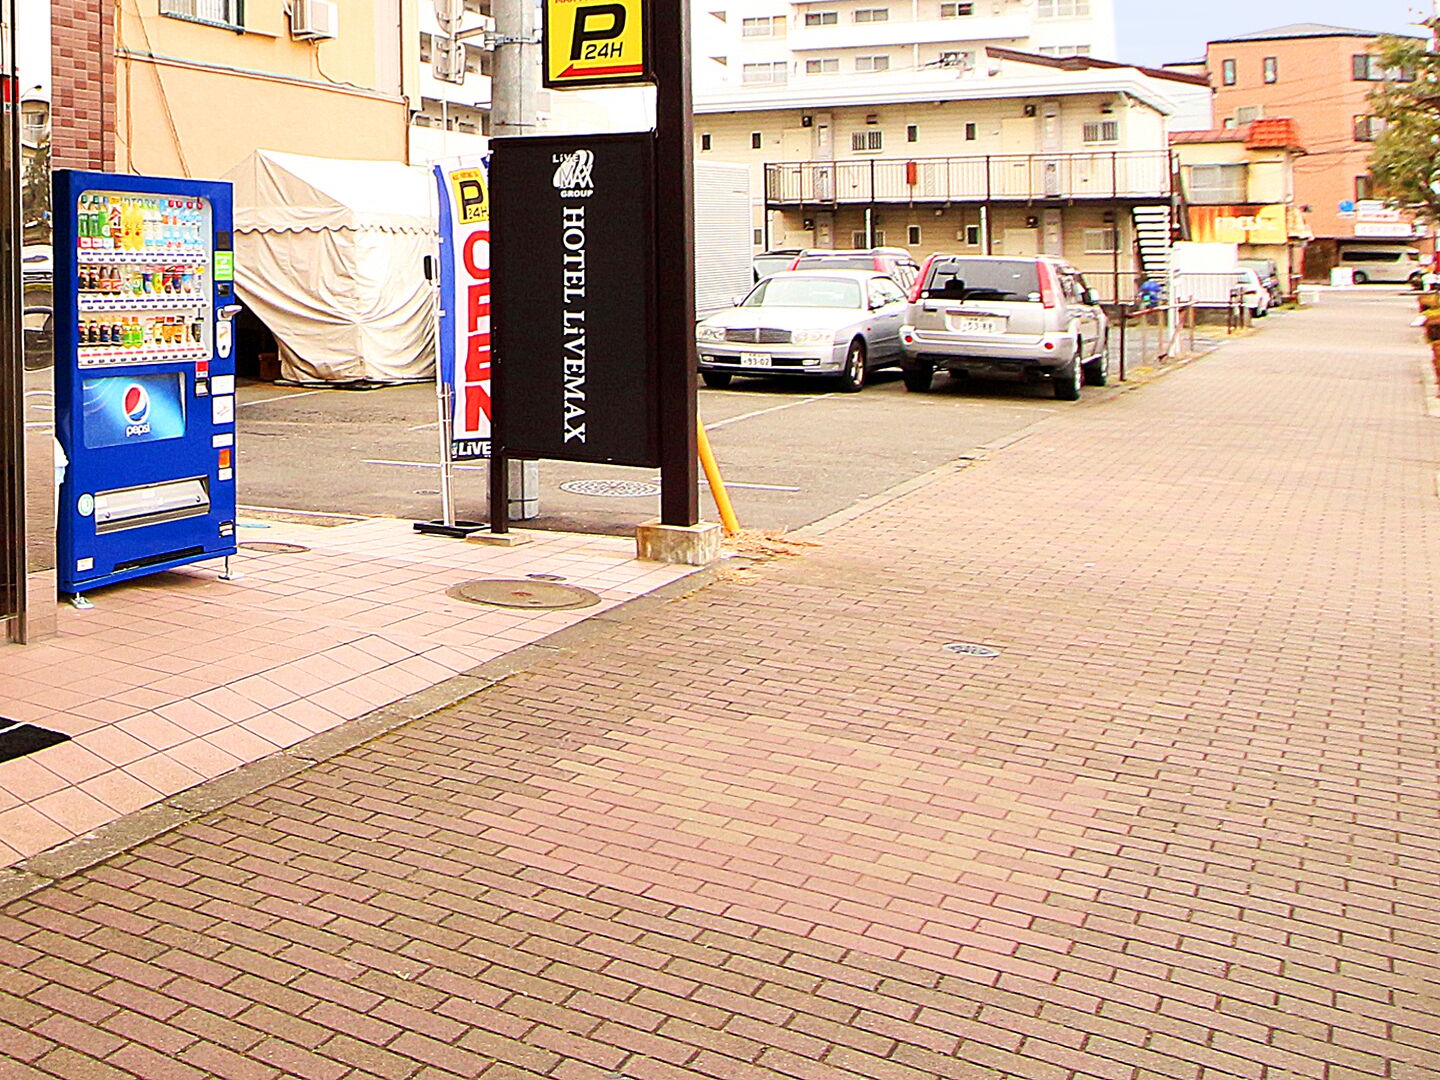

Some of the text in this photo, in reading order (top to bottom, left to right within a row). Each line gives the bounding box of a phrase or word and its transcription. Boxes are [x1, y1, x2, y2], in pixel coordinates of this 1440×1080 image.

[570, 3, 626, 60] P
[585, 41, 623, 60] 24H
[560, 163, 594, 189] MAX
[459, 179, 484, 220] P
[560, 189, 594, 198] GROUP
[563, 206, 586, 303] HOTEL
[126, 422, 151, 438] pepsi
